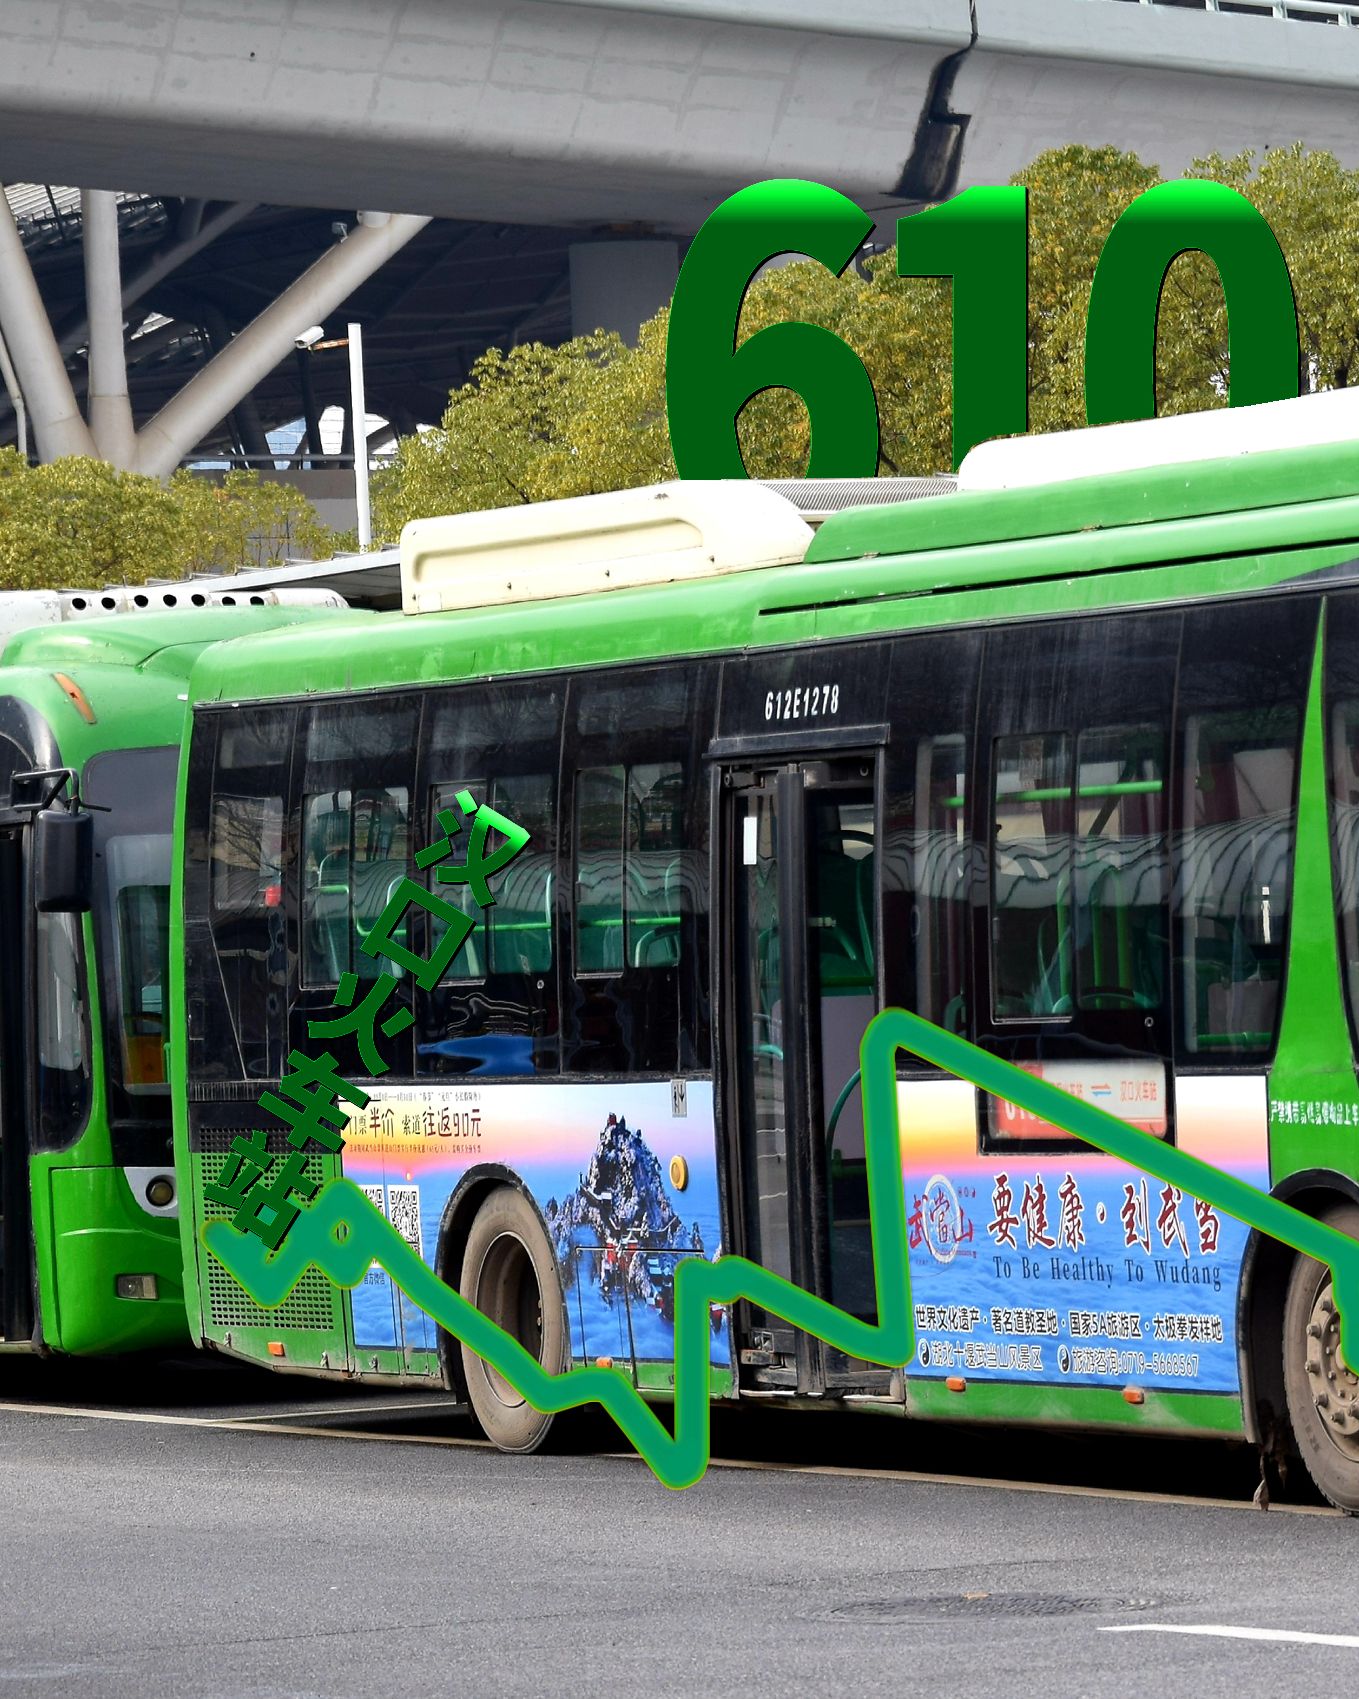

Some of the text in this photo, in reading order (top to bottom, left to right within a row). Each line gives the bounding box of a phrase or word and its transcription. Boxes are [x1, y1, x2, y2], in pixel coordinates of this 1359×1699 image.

[765, 684, 839, 720] 612E1278
[993, 1256, 1221, 1292] To Be Healthy To Wudang
